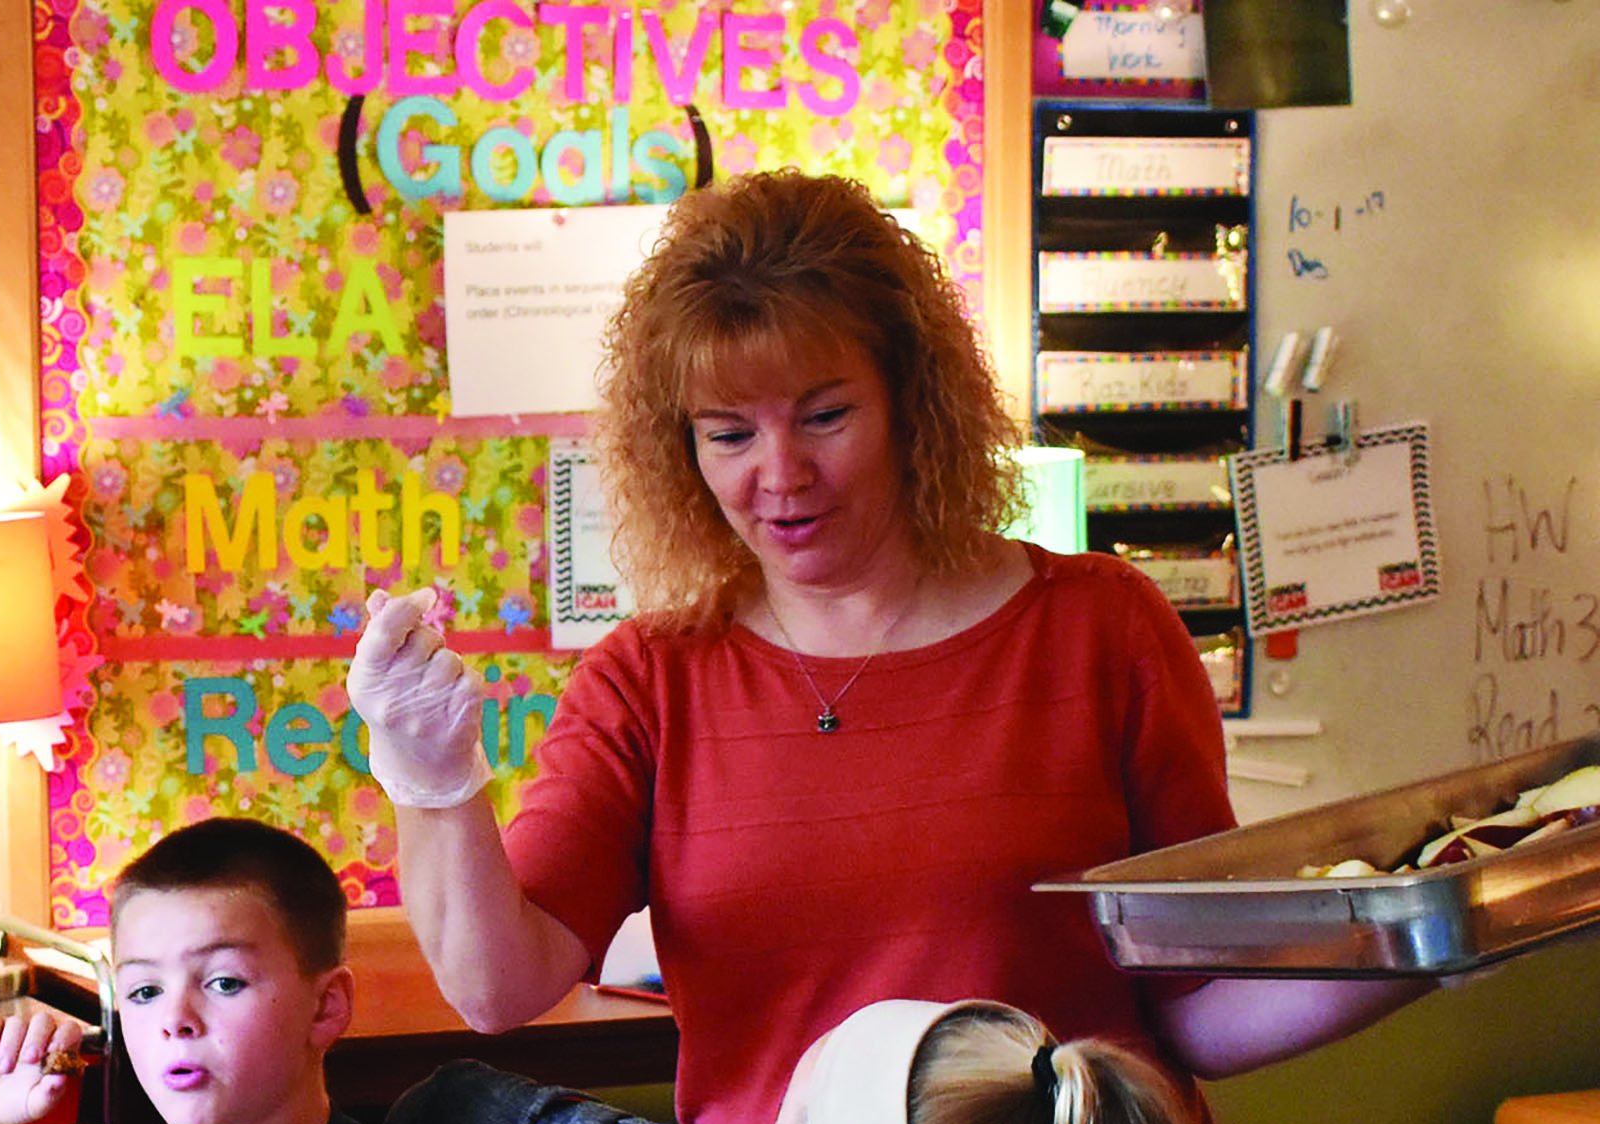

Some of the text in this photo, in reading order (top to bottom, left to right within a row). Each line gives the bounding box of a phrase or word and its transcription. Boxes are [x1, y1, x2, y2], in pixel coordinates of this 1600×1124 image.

[150, 0, 862, 117] OBJECTIVES
[170, 258, 405, 358] ELA
[184, 470, 460, 574] Math
[1483, 473, 1577, 564] HW
[1475, 578, 1564, 662] Math
